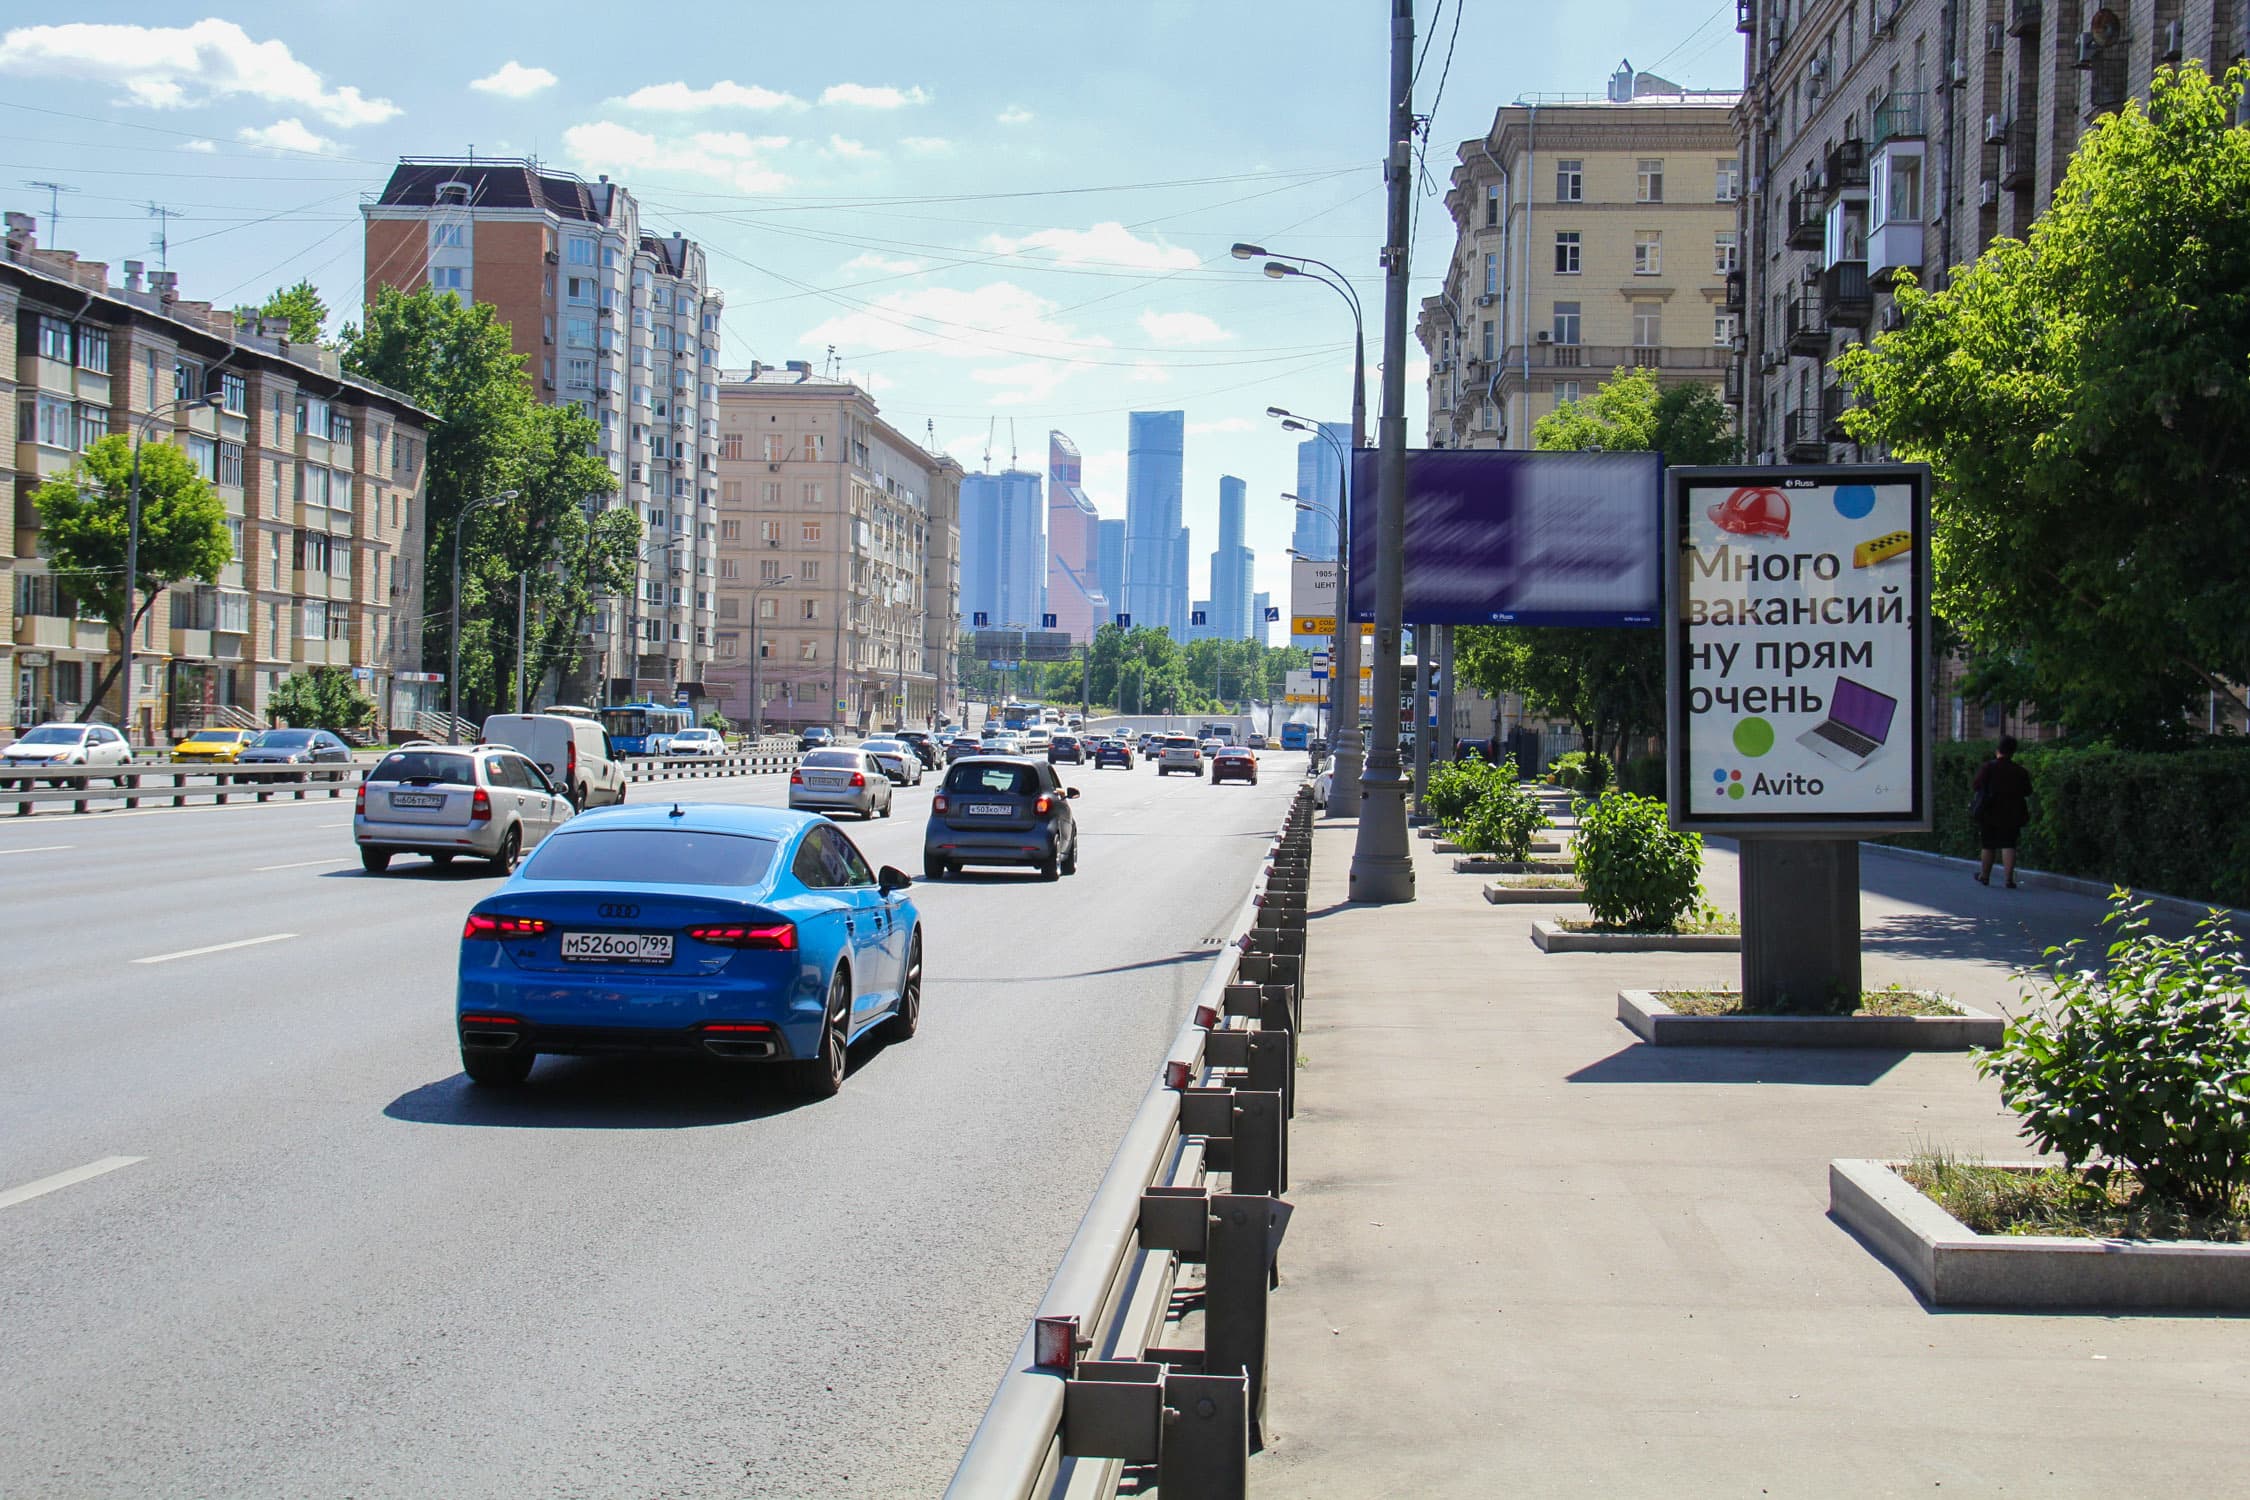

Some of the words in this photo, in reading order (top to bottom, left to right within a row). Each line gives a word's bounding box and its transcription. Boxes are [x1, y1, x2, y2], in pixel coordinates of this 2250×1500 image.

[1794, 479, 1815, 487] Russ
[1689, 545, 1840, 582] Много
[1689, 642, 1741, 678] ну
[1756, 641, 1873, 677] прям
[1689, 684, 1823, 714] очень
[1751, 772, 1824, 796] Avito
